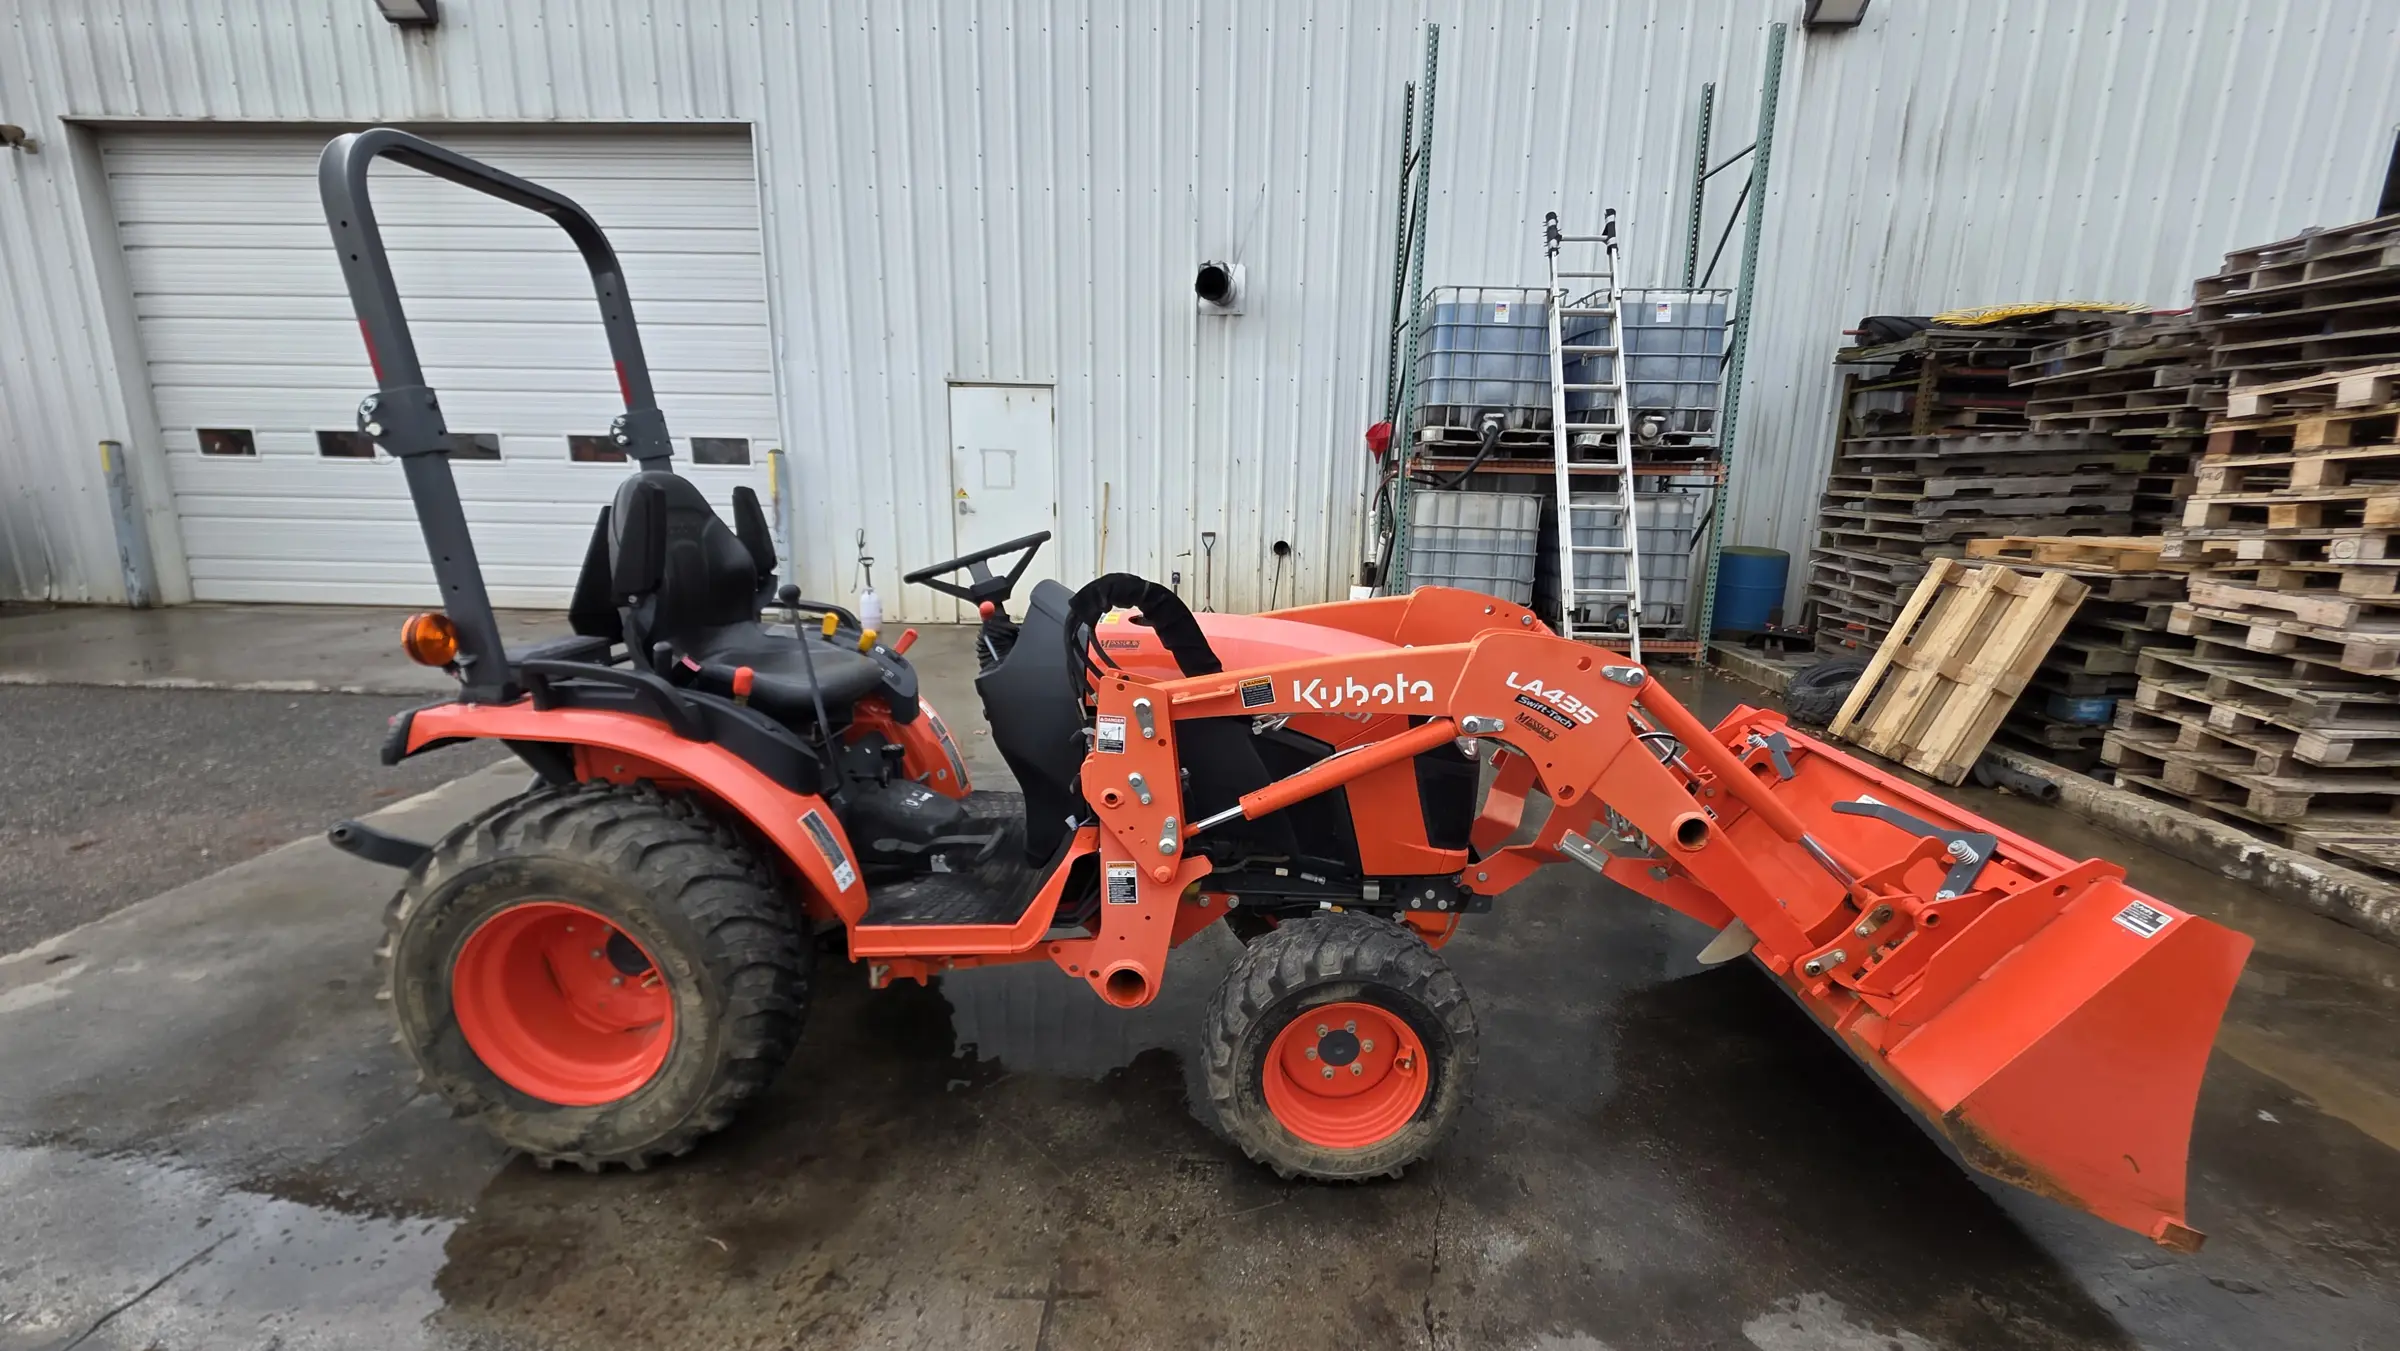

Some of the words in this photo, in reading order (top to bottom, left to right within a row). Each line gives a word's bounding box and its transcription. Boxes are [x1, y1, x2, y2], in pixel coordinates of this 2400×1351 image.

[1293, 673, 1434, 708] Kubota
[1505, 671, 1599, 725] LA435
[1519, 696, 1573, 728] Swift-Tach
